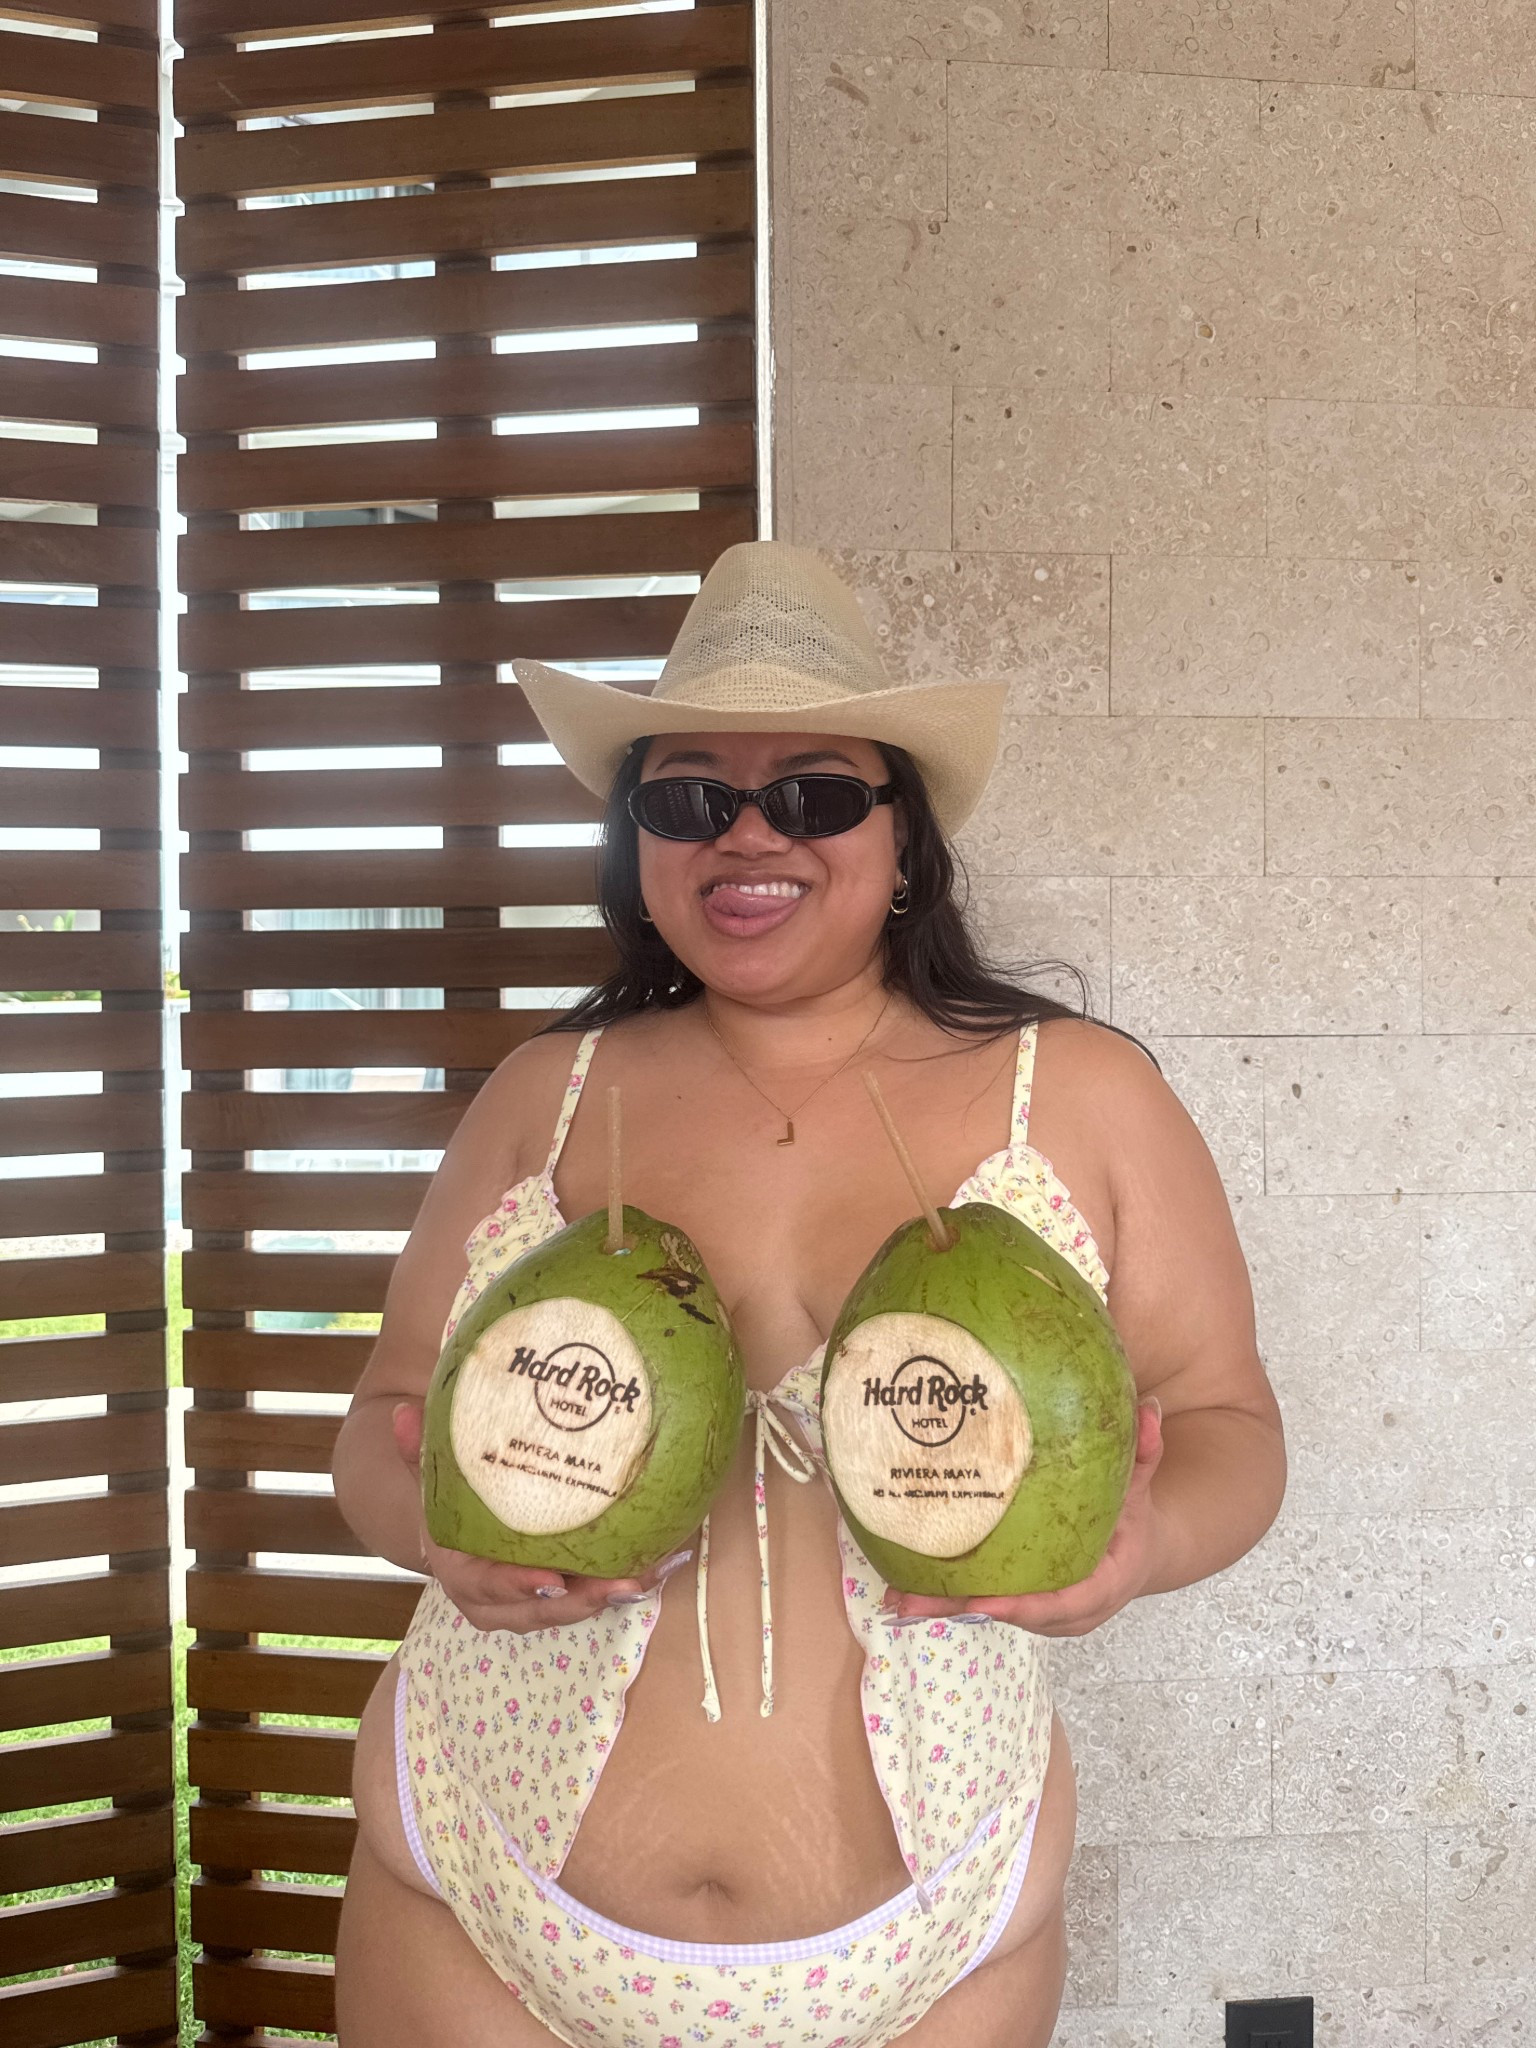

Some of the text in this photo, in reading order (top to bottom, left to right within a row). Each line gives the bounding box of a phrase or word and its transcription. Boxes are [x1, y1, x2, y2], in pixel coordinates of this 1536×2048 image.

[508, 1346, 641, 1413] Hard Rock
[862, 1374, 988, 1412] Hard Rock
[550, 1399, 587, 1417] HOTEL
[911, 1418, 948, 1429] HOTEL
[509, 1438, 560, 1461] RIVIERA
[564, 1454, 601, 1473] MAYA
[890, 1468, 981, 1479] RIVIERA MAYA
